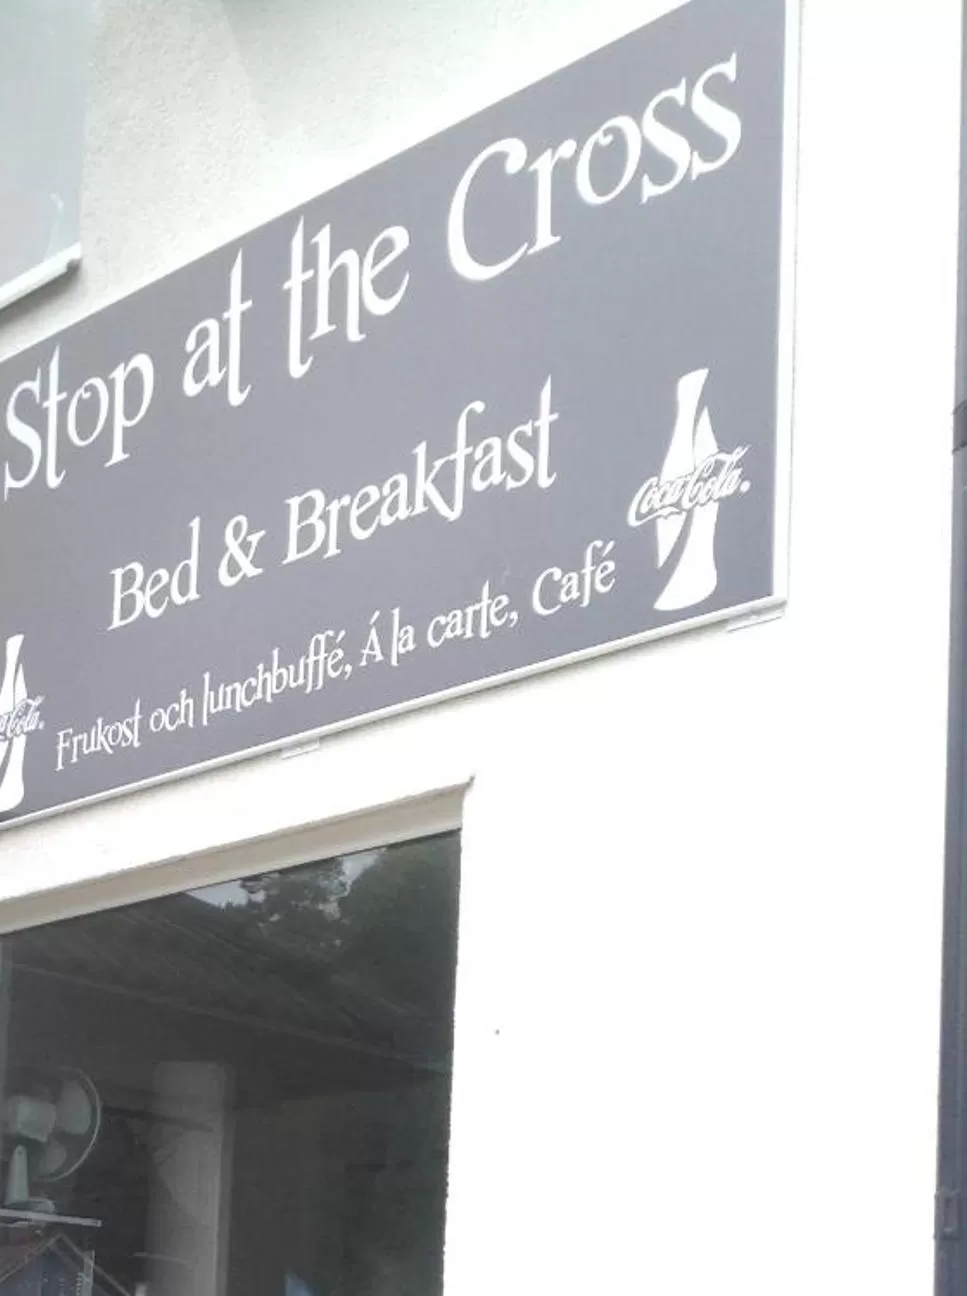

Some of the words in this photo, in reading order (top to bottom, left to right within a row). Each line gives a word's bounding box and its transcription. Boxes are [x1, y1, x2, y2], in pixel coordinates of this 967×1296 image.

[3, 346, 154, 502] Stop
[182, 248, 253, 408] at
[281, 214, 411, 380] the
[446, 51, 743, 283] Cross
[106, 515, 201, 631] Bed
[217, 514, 267, 588] &
[281, 375, 560, 566] Breakfast
[55, 697, 142, 772] Frukost
[149, 688, 195, 735] och
[202, 629, 354, 727] lunchbuffé,
[390, 606, 416, 668] la
[426, 579, 520, 649] carte,
[531, 540, 617, 617] Café
